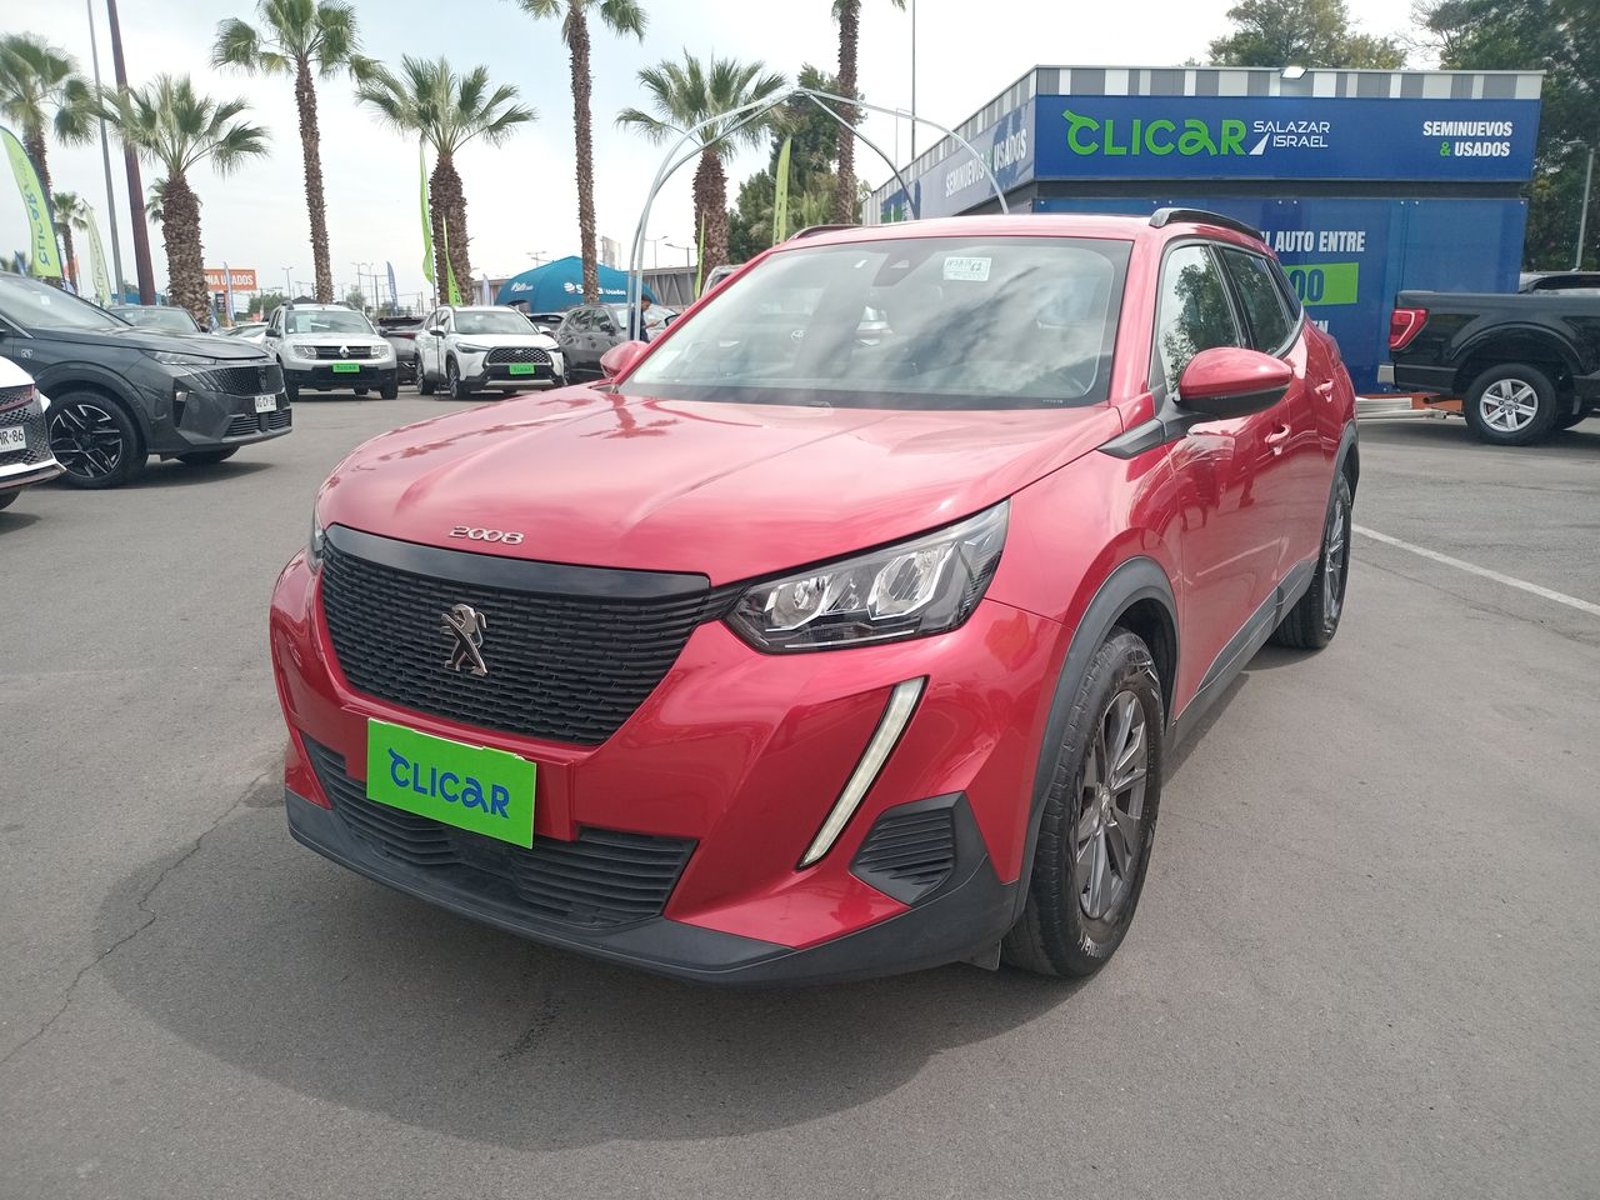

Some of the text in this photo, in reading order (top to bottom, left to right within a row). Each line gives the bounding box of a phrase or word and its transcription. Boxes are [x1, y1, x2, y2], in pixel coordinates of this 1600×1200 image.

[1253, 121, 1330, 134] SALAZAR
[1423, 121, 1513, 137] SEMINUEVOS
[1273, 135, 1328, 148] ISRAEL
[1439, 141, 1510, 157] & USADOS
[993, 128, 1027, 172] USADOS
[1274, 230, 1315, 252] AUTO
[1318, 230, 1366, 252] ENTRE
[220, 274, 254, 286] UADOS
[448, 525, 525, 545] 2008
